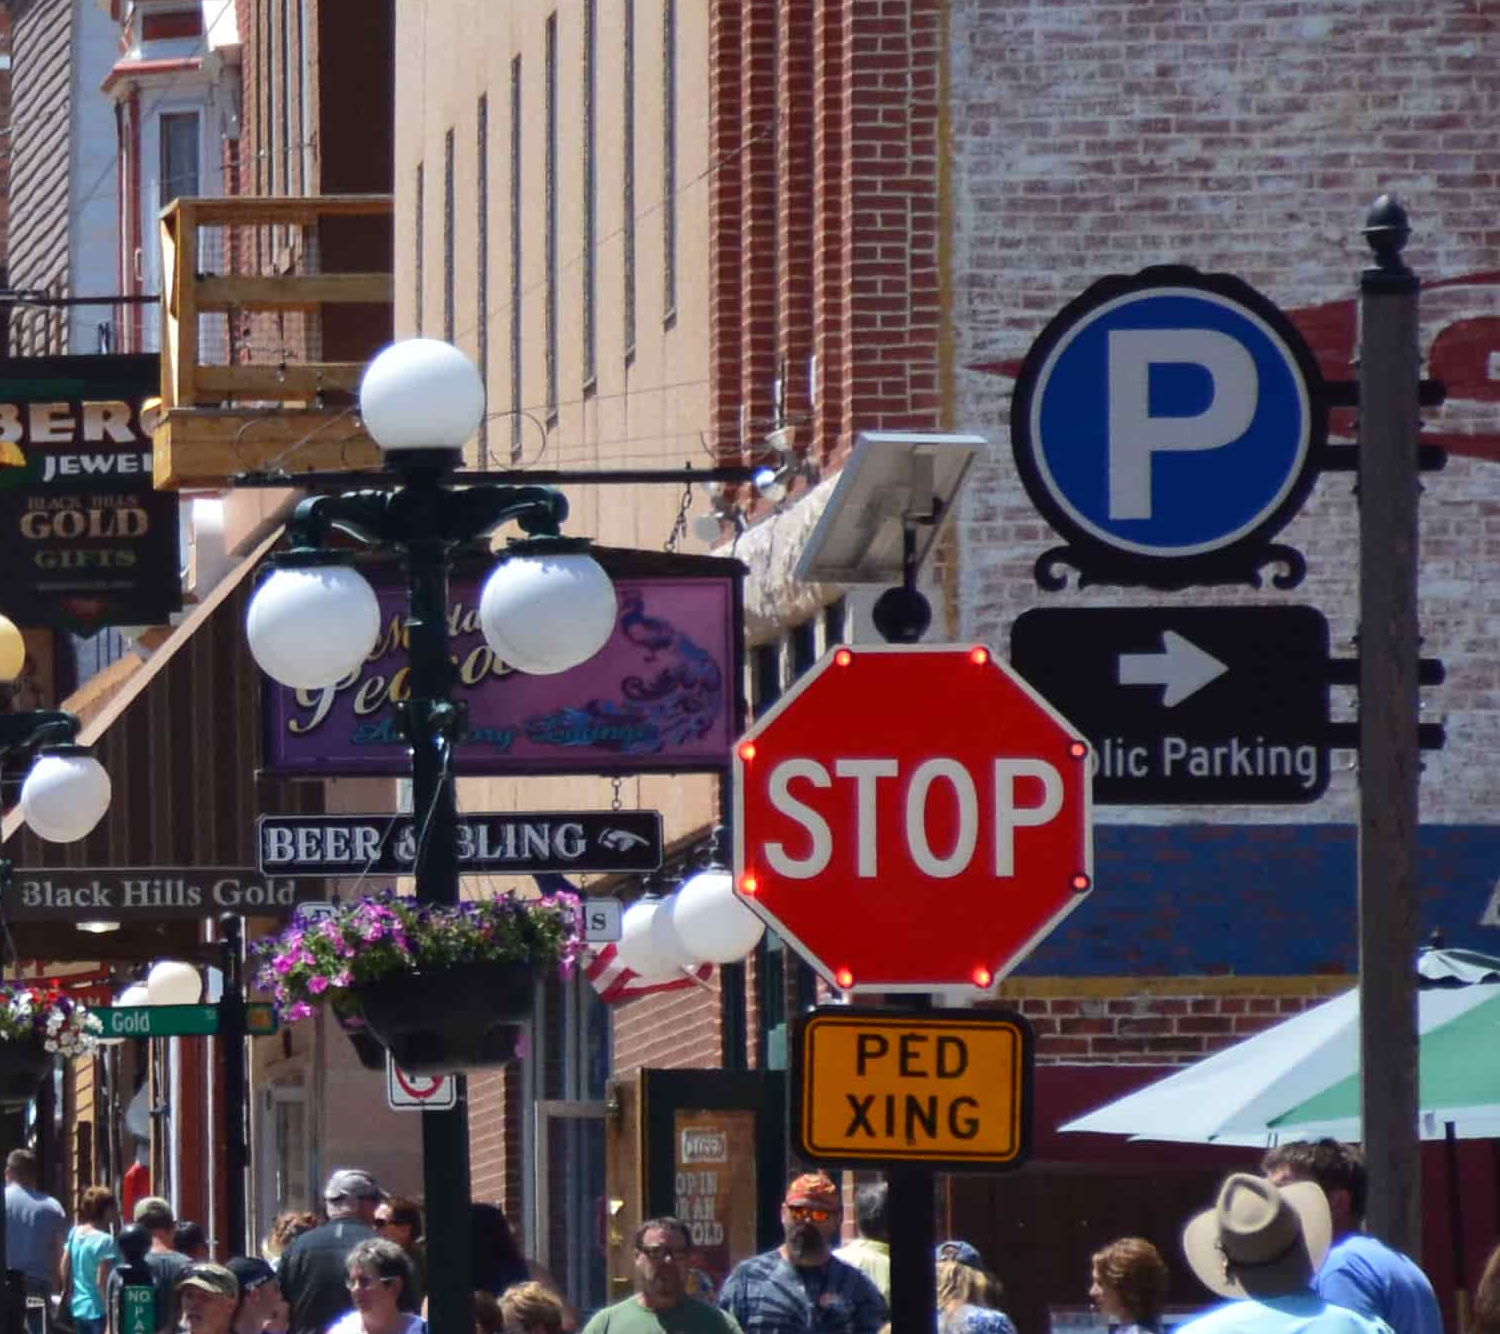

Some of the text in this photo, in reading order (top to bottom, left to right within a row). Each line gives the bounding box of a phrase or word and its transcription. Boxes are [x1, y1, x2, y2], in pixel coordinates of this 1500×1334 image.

[1107, 328, 1259, 521] P
[20, 508, 149, 540] GOLD
[34, 549, 137, 570] GIFTS
[1163, 737, 1318, 788] Parking
[763, 757, 1066, 880] STOP
[266, 827, 382, 863] BEER
[22, 880, 297, 908] Black Hills Gold
[111, 1011, 150, 1033] Gold
[856, 1033, 969, 1079] PED
[844, 1095, 980, 1142] XING
[128, 1290, 152, 1302] NO
